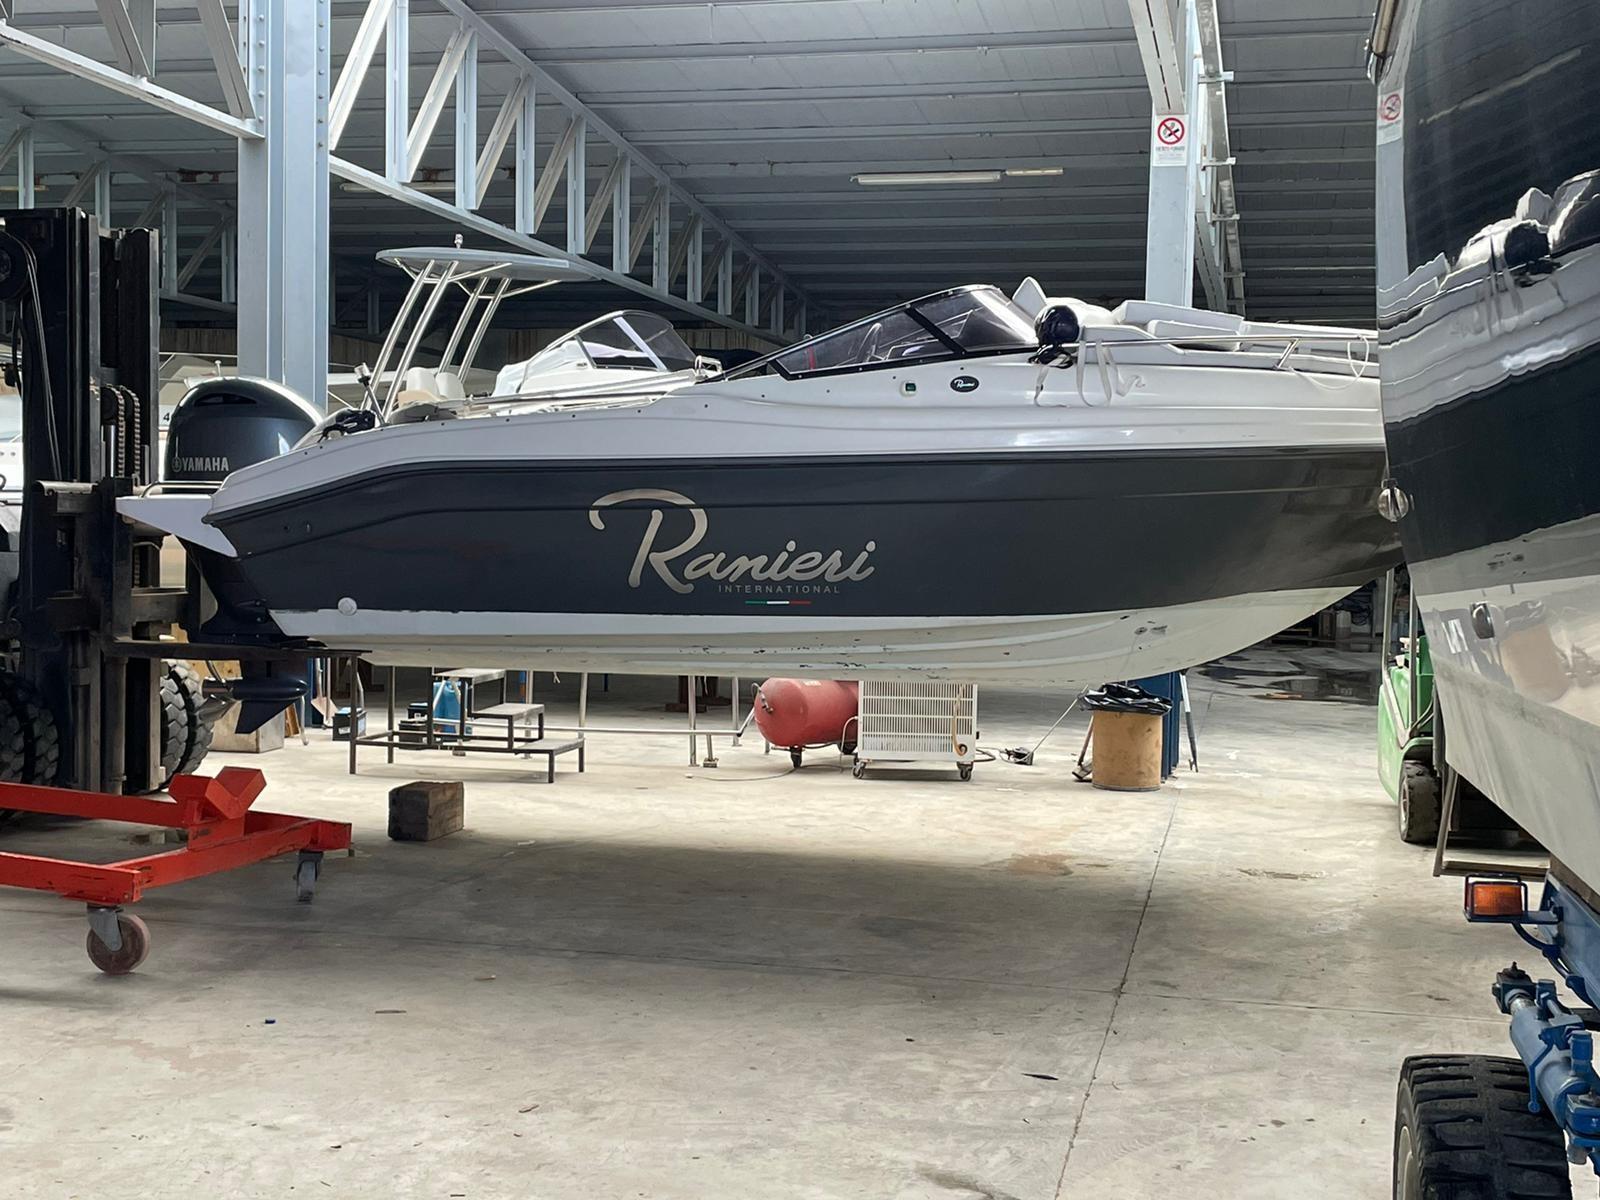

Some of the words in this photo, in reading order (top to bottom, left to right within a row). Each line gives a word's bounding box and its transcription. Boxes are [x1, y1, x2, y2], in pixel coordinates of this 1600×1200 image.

[182, 457, 229, 471] YAMAHA
[588, 488, 877, 594] Ranieri
[718, 584, 840, 594] INTERNATIONAL
